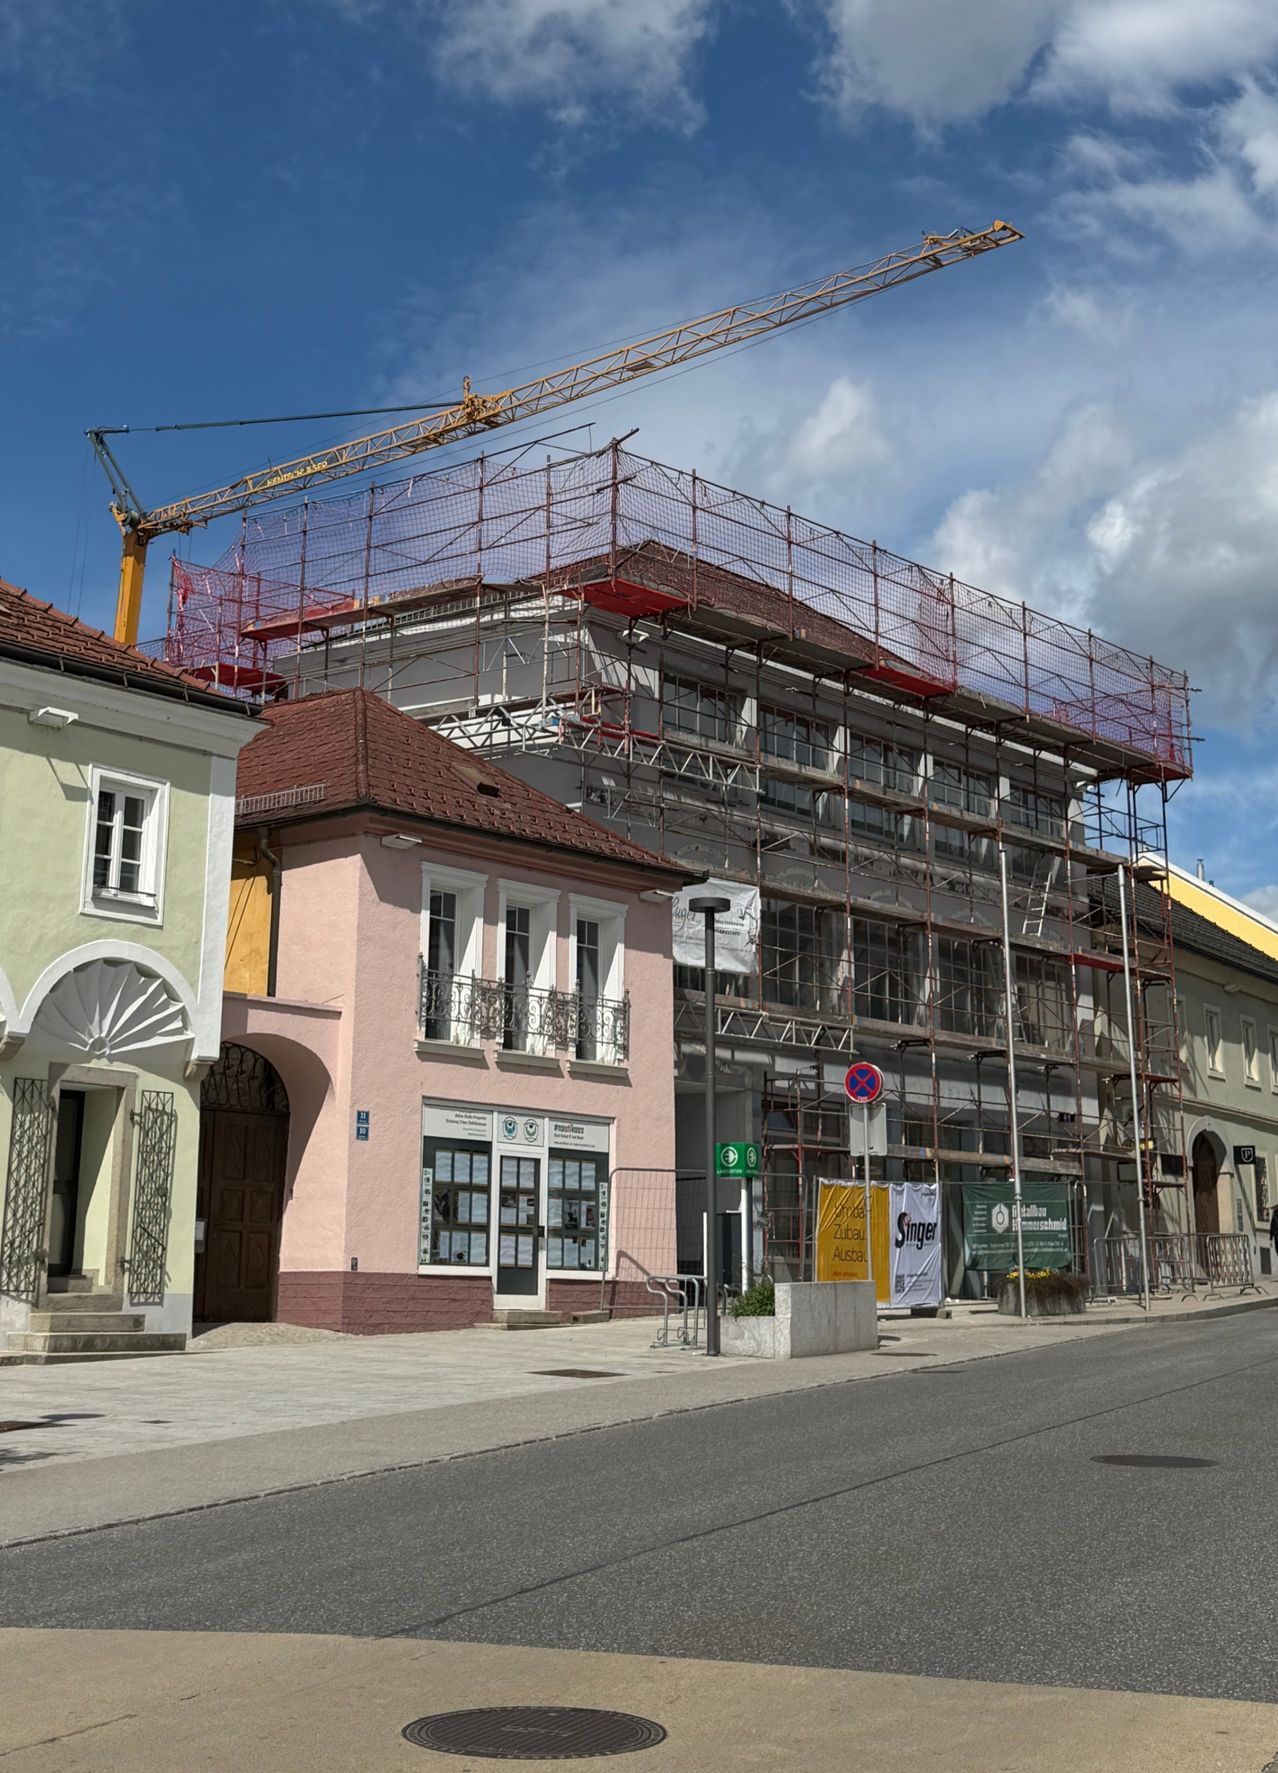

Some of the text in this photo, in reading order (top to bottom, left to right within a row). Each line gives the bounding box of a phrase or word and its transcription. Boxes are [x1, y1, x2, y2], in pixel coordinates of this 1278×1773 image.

[1012, 1204, 1047, 1218] Mtallbau
[895, 1212, 938, 1250] Singer
[1012, 1217, 1067, 1232] Hmmerschmid
